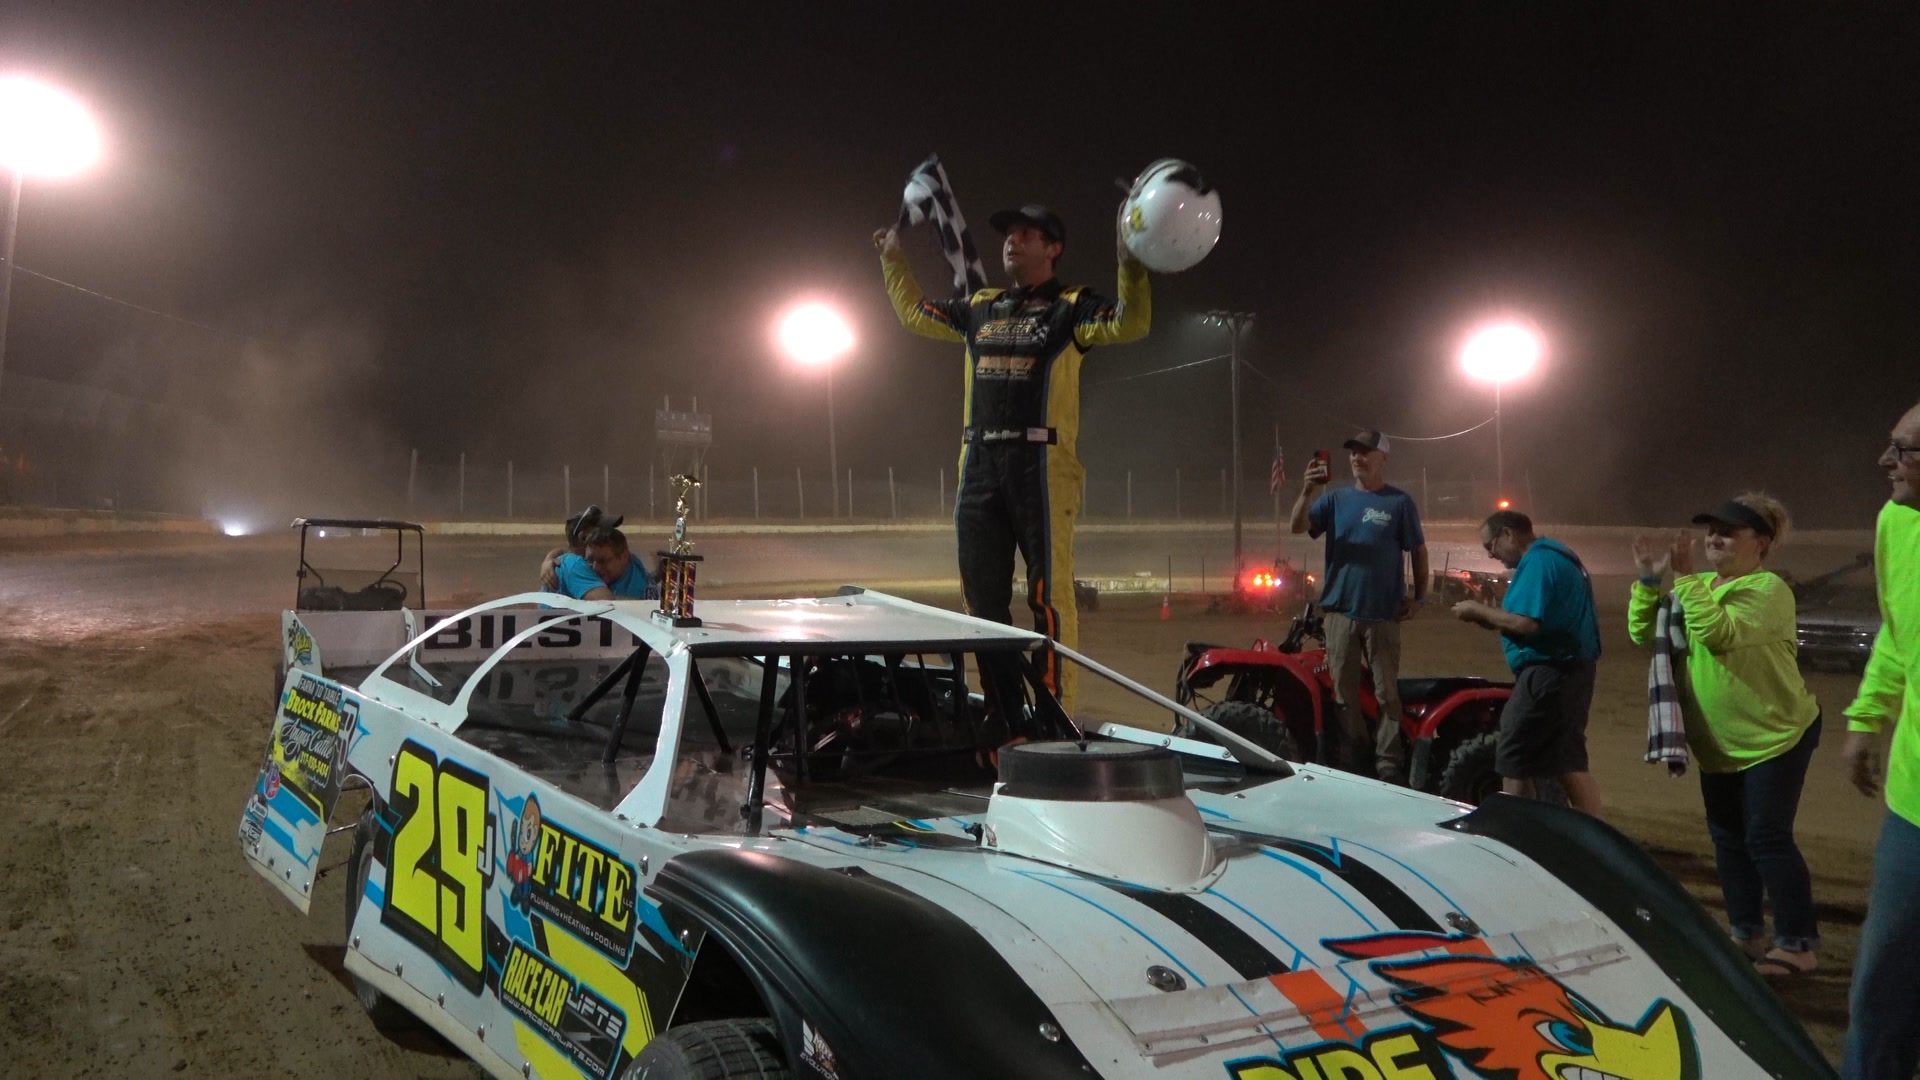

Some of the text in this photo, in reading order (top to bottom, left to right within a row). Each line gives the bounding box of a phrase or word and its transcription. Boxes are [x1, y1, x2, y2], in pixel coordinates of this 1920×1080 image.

[424, 615, 648, 650] BILST
[286, 689, 341, 733] BROCK FARMS
[299, 677, 315, 696] FARM
[324, 686, 341, 706] TABLE
[282, 718, 310, 755] Angus
[309, 730, 333, 759] Cattle
[533, 823, 634, 933] FITE LLC
